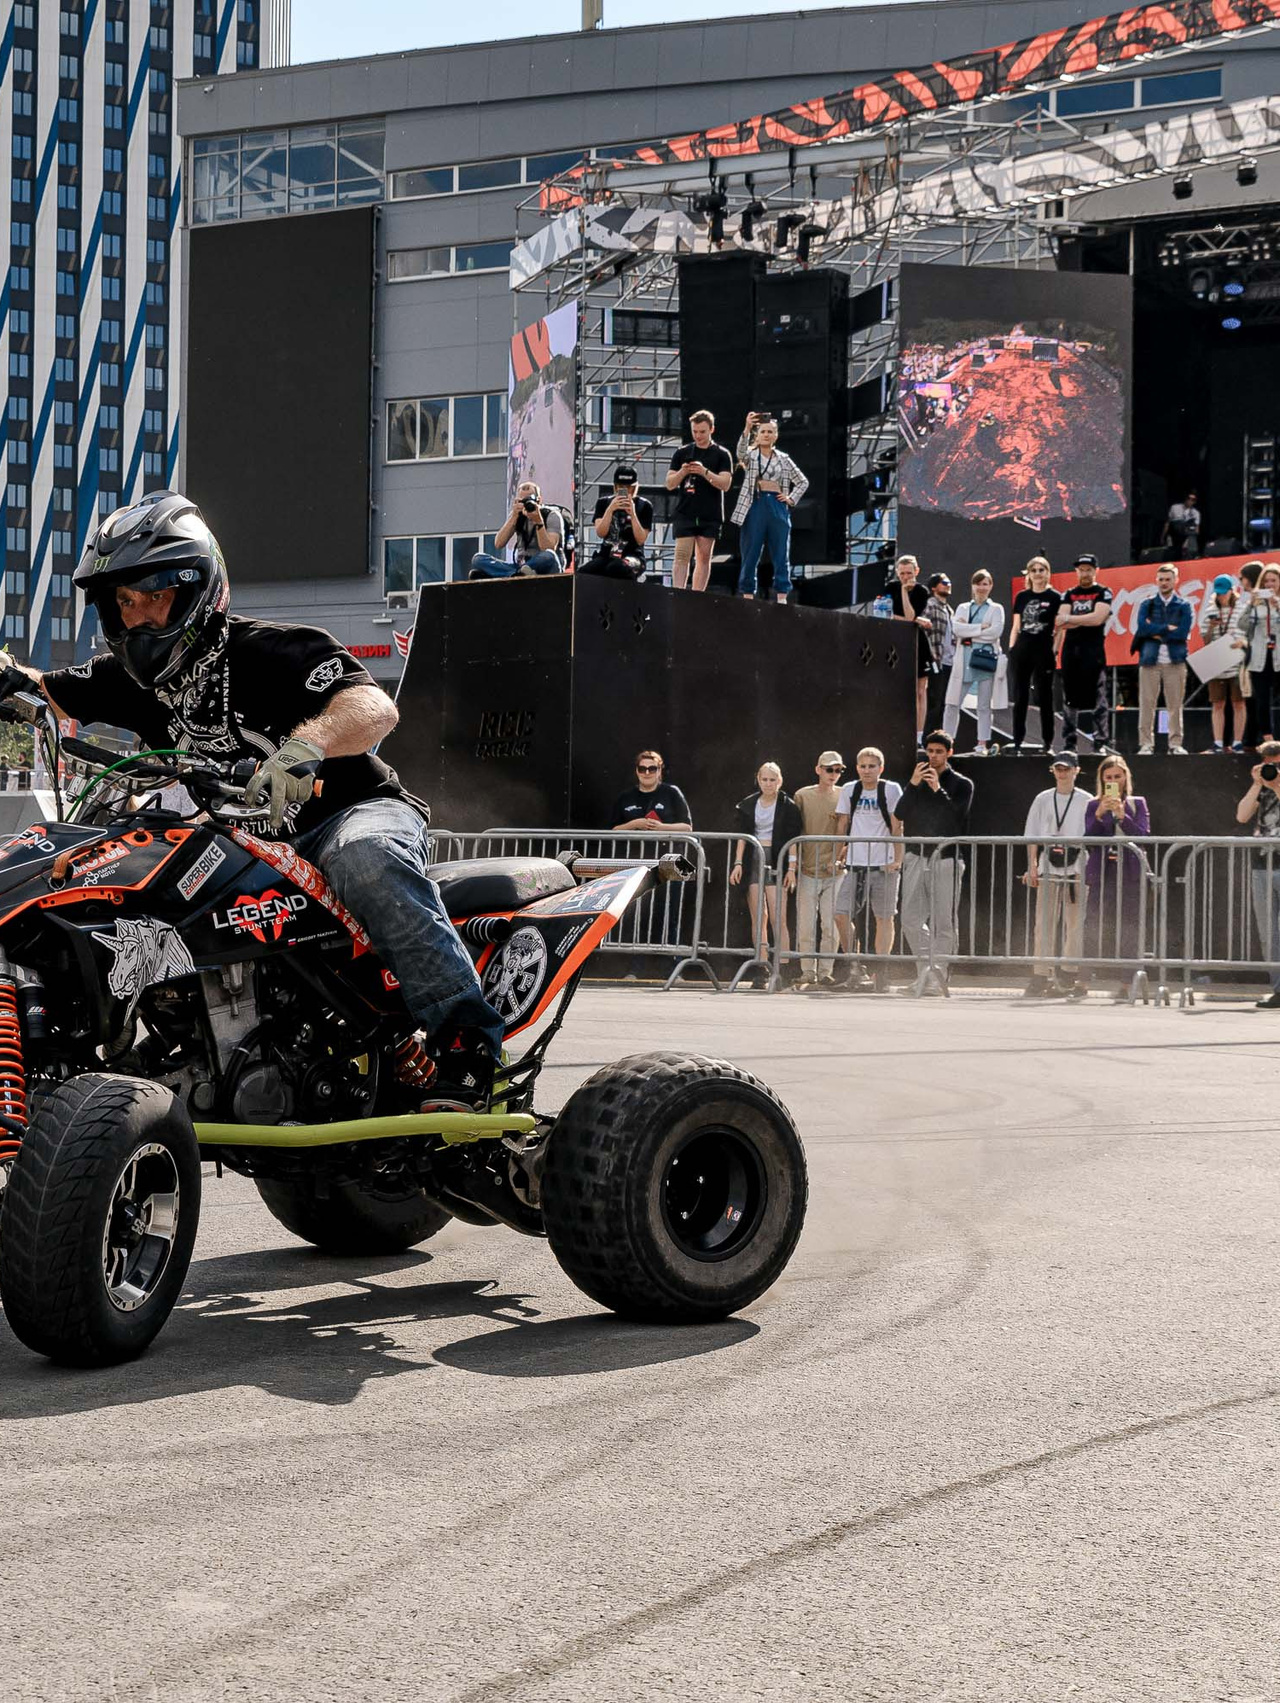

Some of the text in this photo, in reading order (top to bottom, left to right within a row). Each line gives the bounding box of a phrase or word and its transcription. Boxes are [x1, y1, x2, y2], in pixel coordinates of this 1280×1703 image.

[180, 867, 203, 892] SUPER
[200, 845, 223, 875] BIKE
[212, 894, 308, 930] LEGEND
[234, 914, 297, 935] STUNT TEAM
